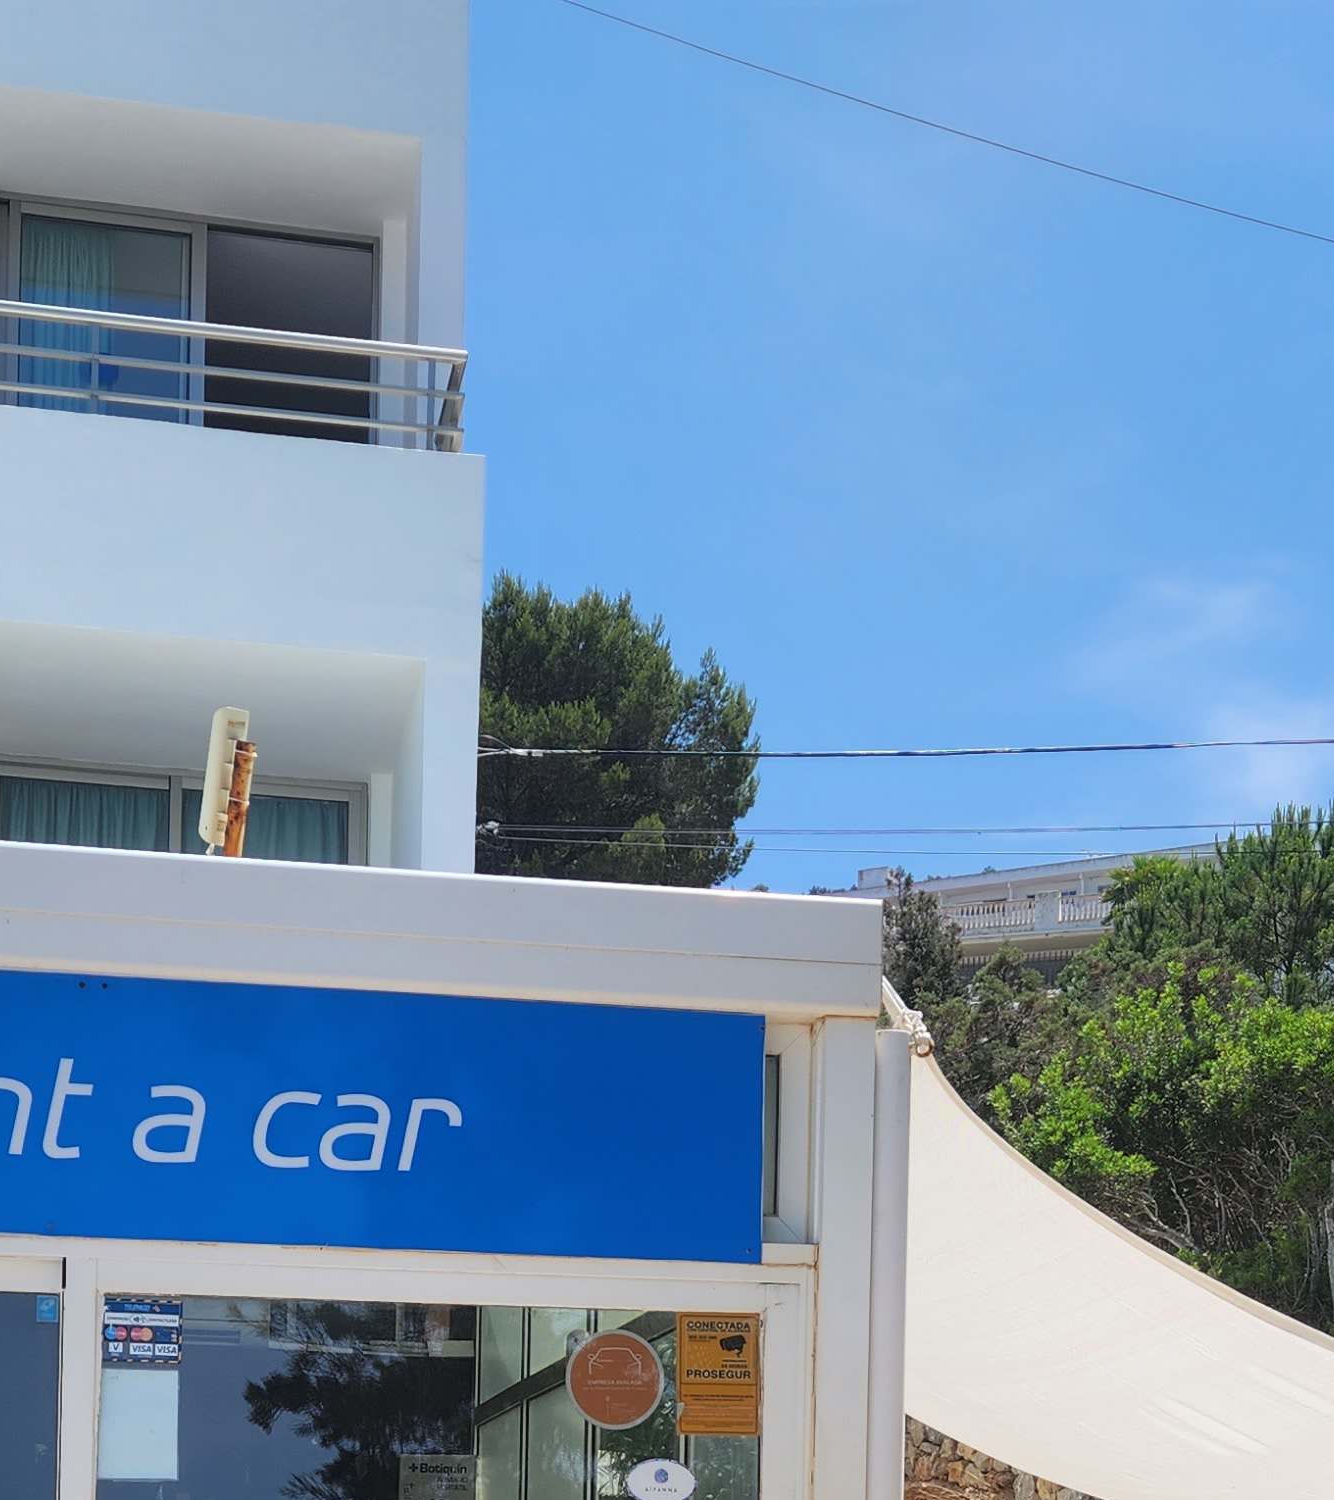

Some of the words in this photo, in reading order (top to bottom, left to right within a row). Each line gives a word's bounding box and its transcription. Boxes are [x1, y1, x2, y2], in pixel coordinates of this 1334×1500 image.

[131, 1085, 206, 1164] a
[252, 1089, 463, 1173] car
[686, 1320, 751, 1330] CONECTADA
[131, 1344, 152, 1353] VISA
[157, 1345, 177, 1354] VISA
[686, 1369, 751, 1380] PROSEGUR
